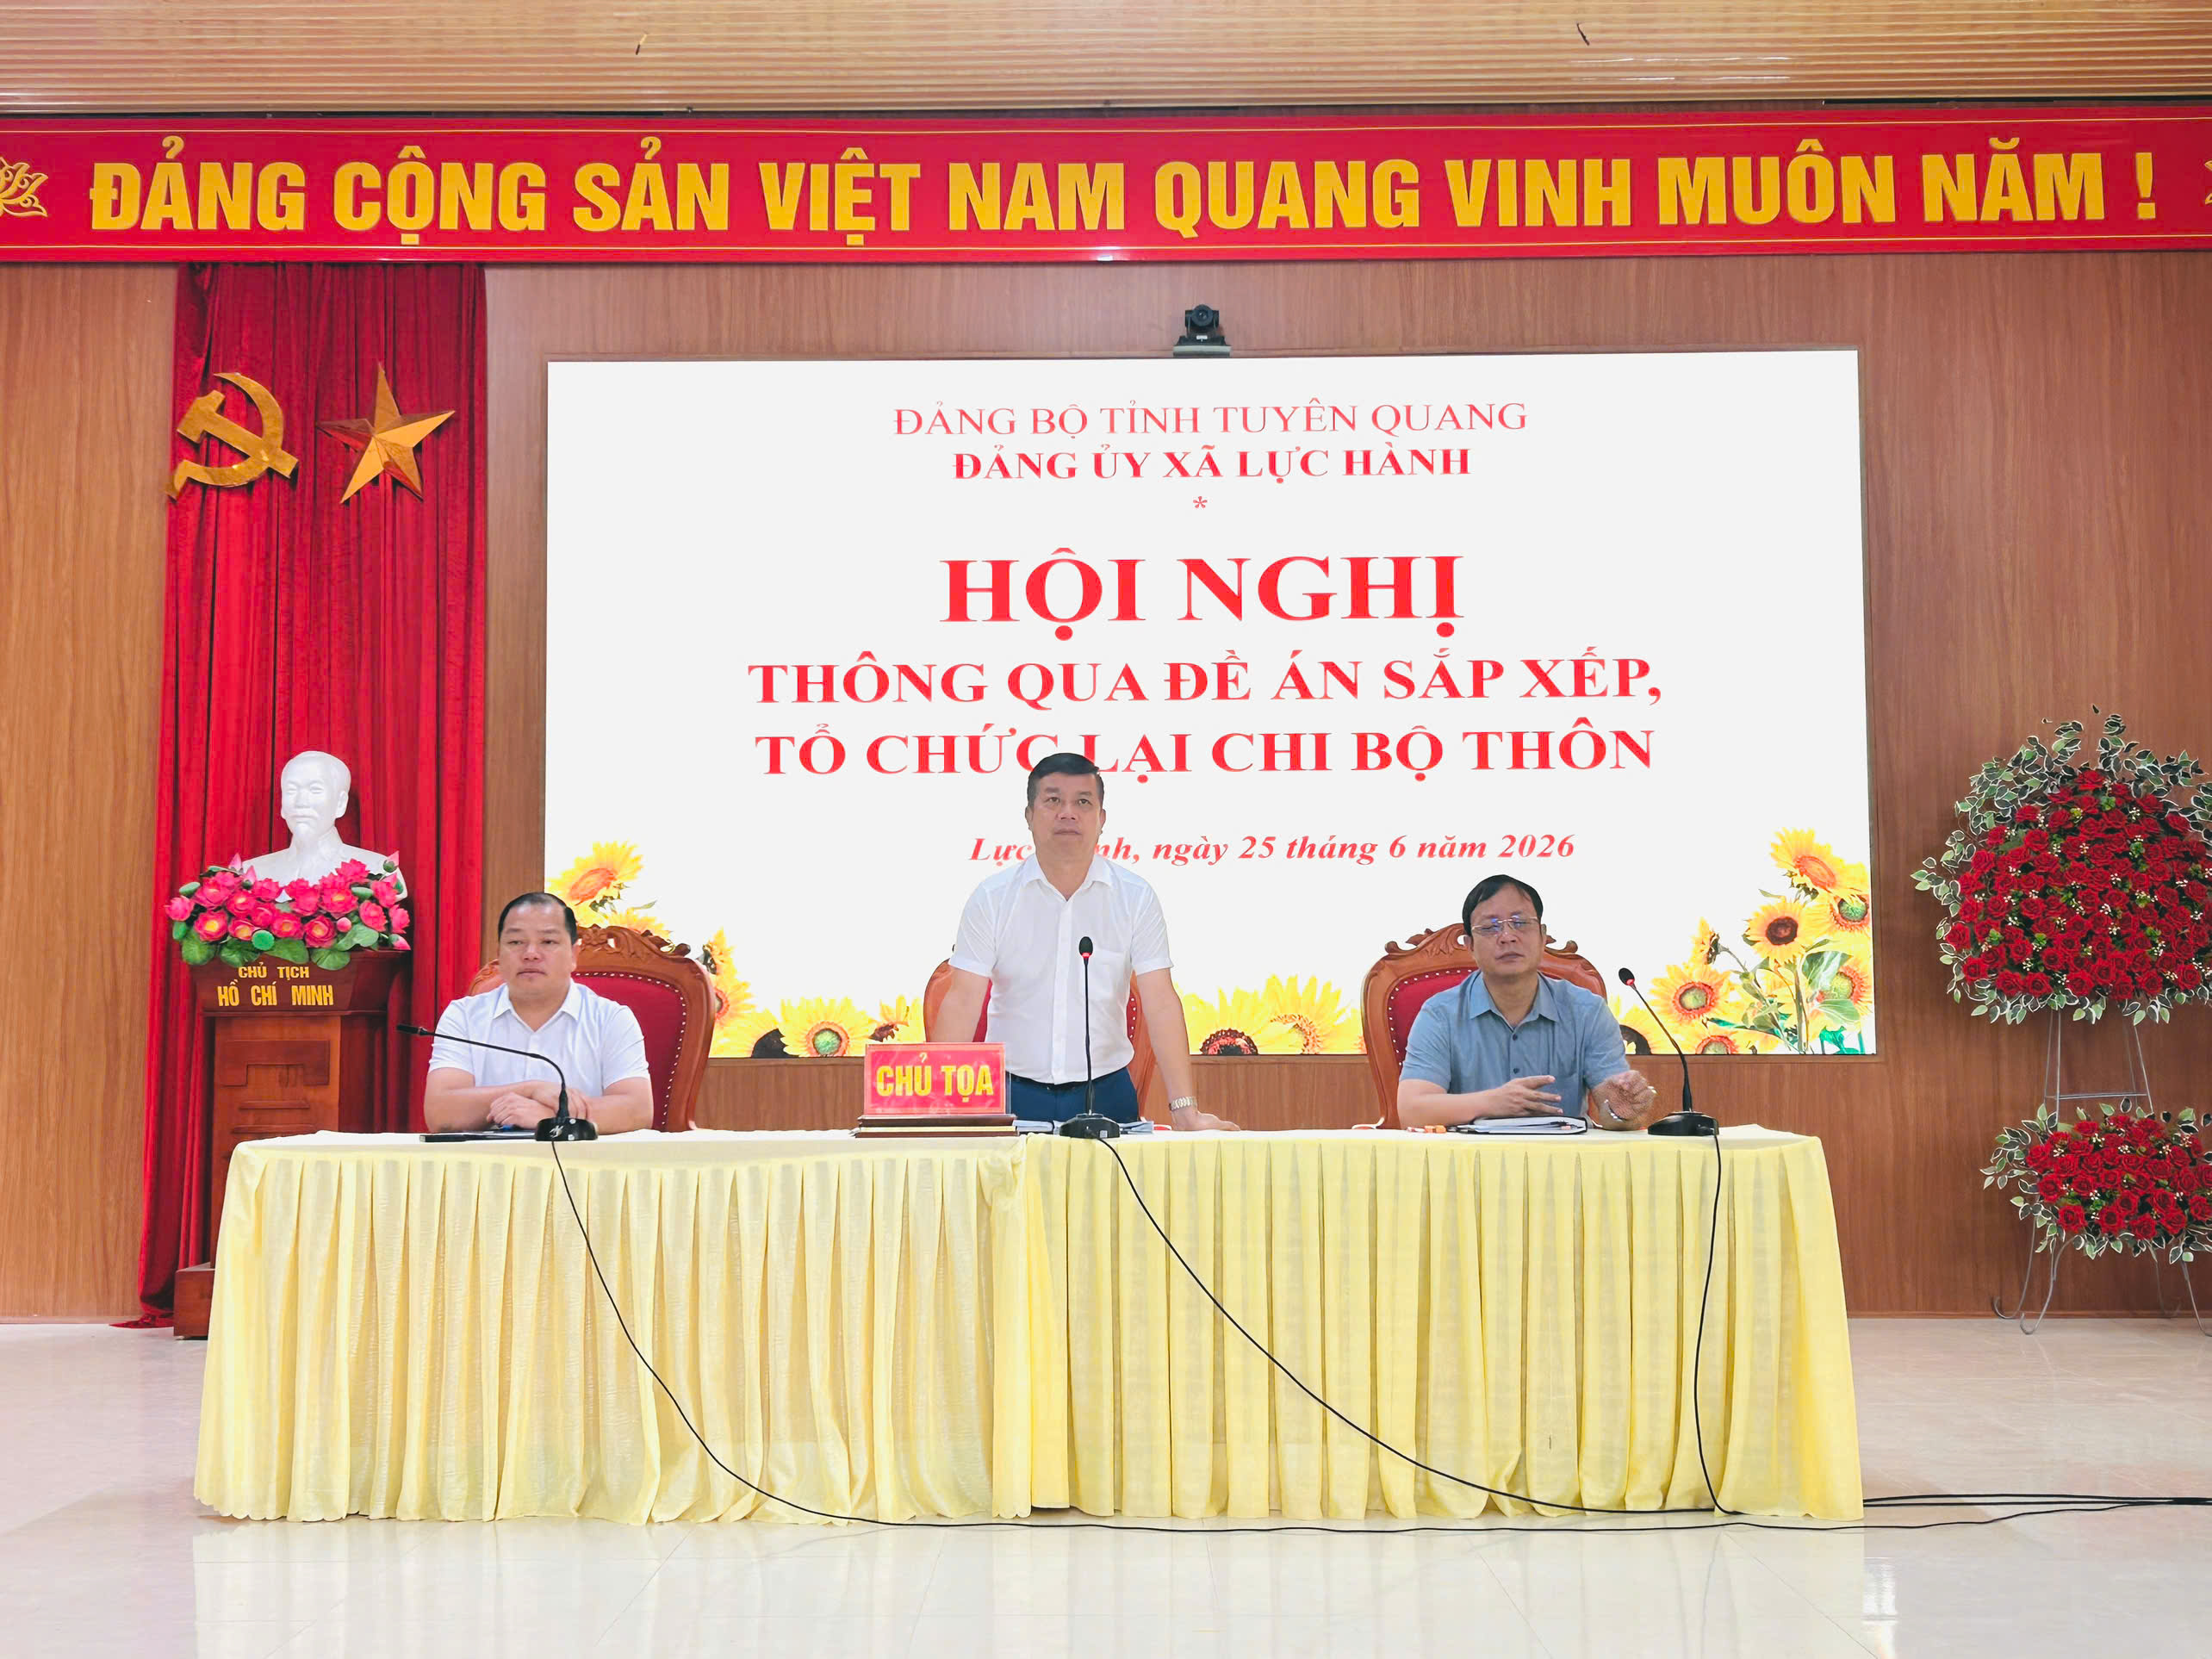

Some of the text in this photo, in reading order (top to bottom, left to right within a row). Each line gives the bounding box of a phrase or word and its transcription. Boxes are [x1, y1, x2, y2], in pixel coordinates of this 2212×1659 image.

[90, 135, 2157, 245] ĐẢNG CỘNG SẢN VIỆT NAM QUANG VINH MUÔN NĂM !
[893, 397, 1528, 438] ĐẢNG BỘ TỈNH TUYÊN QUANG
[953, 442, 1471, 484] ĐẢNG ỦY XÃ LỰC HÀNH
[940, 547, 1464, 641] HỘI NGHỊ
[748, 645, 1662, 710] THÔNG QUA ĐỀ ÁN SẮP XẾP,
[755, 716, 1654, 784] TỔ CHỨC LẠI CHI BỘ THÔN
[968, 834, 1575, 867] Lực nh, ngày 25 tháng 6 năm 2026
[217, 979, 334, 1007] HỒ CHÍ MINH
[238, 962, 310, 981] CHỦ TỊCH
[876, 1052, 994, 1103] CHỦ TỌA
